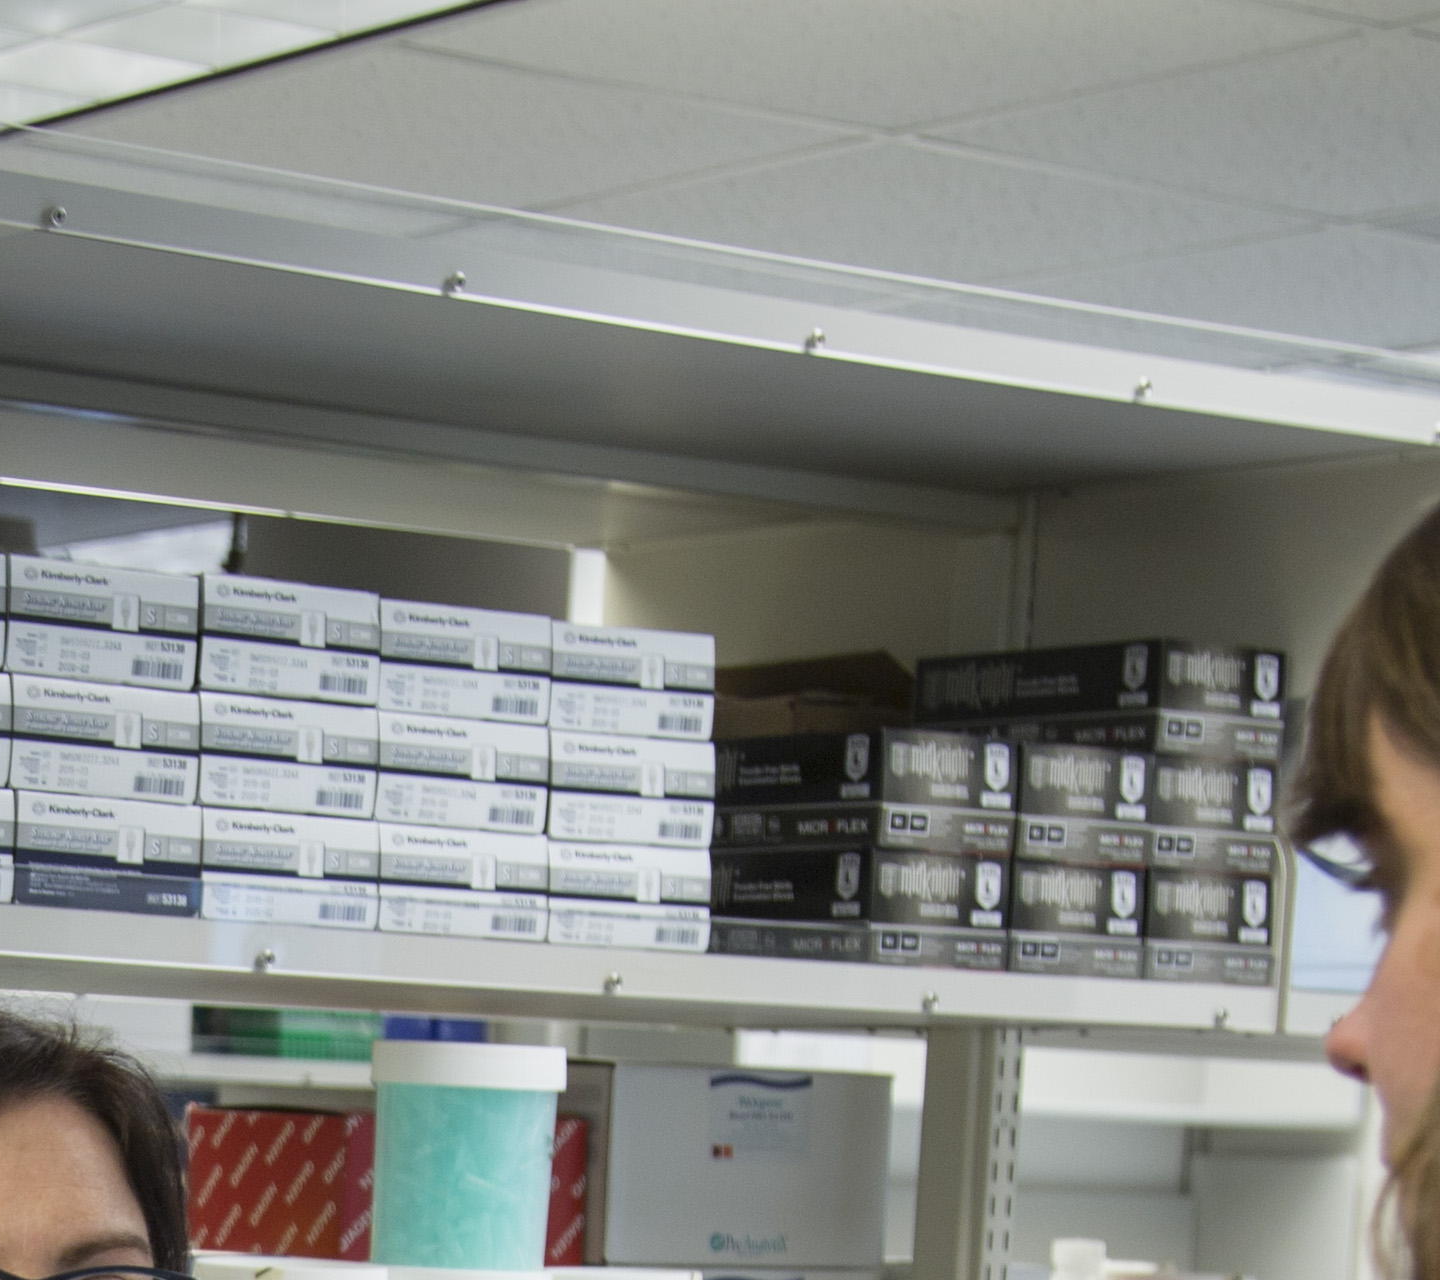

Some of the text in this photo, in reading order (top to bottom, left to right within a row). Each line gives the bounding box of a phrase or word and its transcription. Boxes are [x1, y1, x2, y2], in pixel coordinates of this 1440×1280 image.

[41, 568, 109, 587] Kimberly-Clark
[232, 587, 297, 603] Kimberly-Clark
[147, 608, 157, 625] S
[161, 642, 186, 654] 53138
[43, 688, 111, 703] Kimberly-Clark
[230, 705, 294, 720] Kimberly-Clark
[149, 724, 159, 740] S
[163, 759, 187, 769] 53138
[49, 804, 115, 819] Kimberly-Clark
[232, 820, 295, 835] Kimberly-Clark
[152, 840, 161, 855] S
